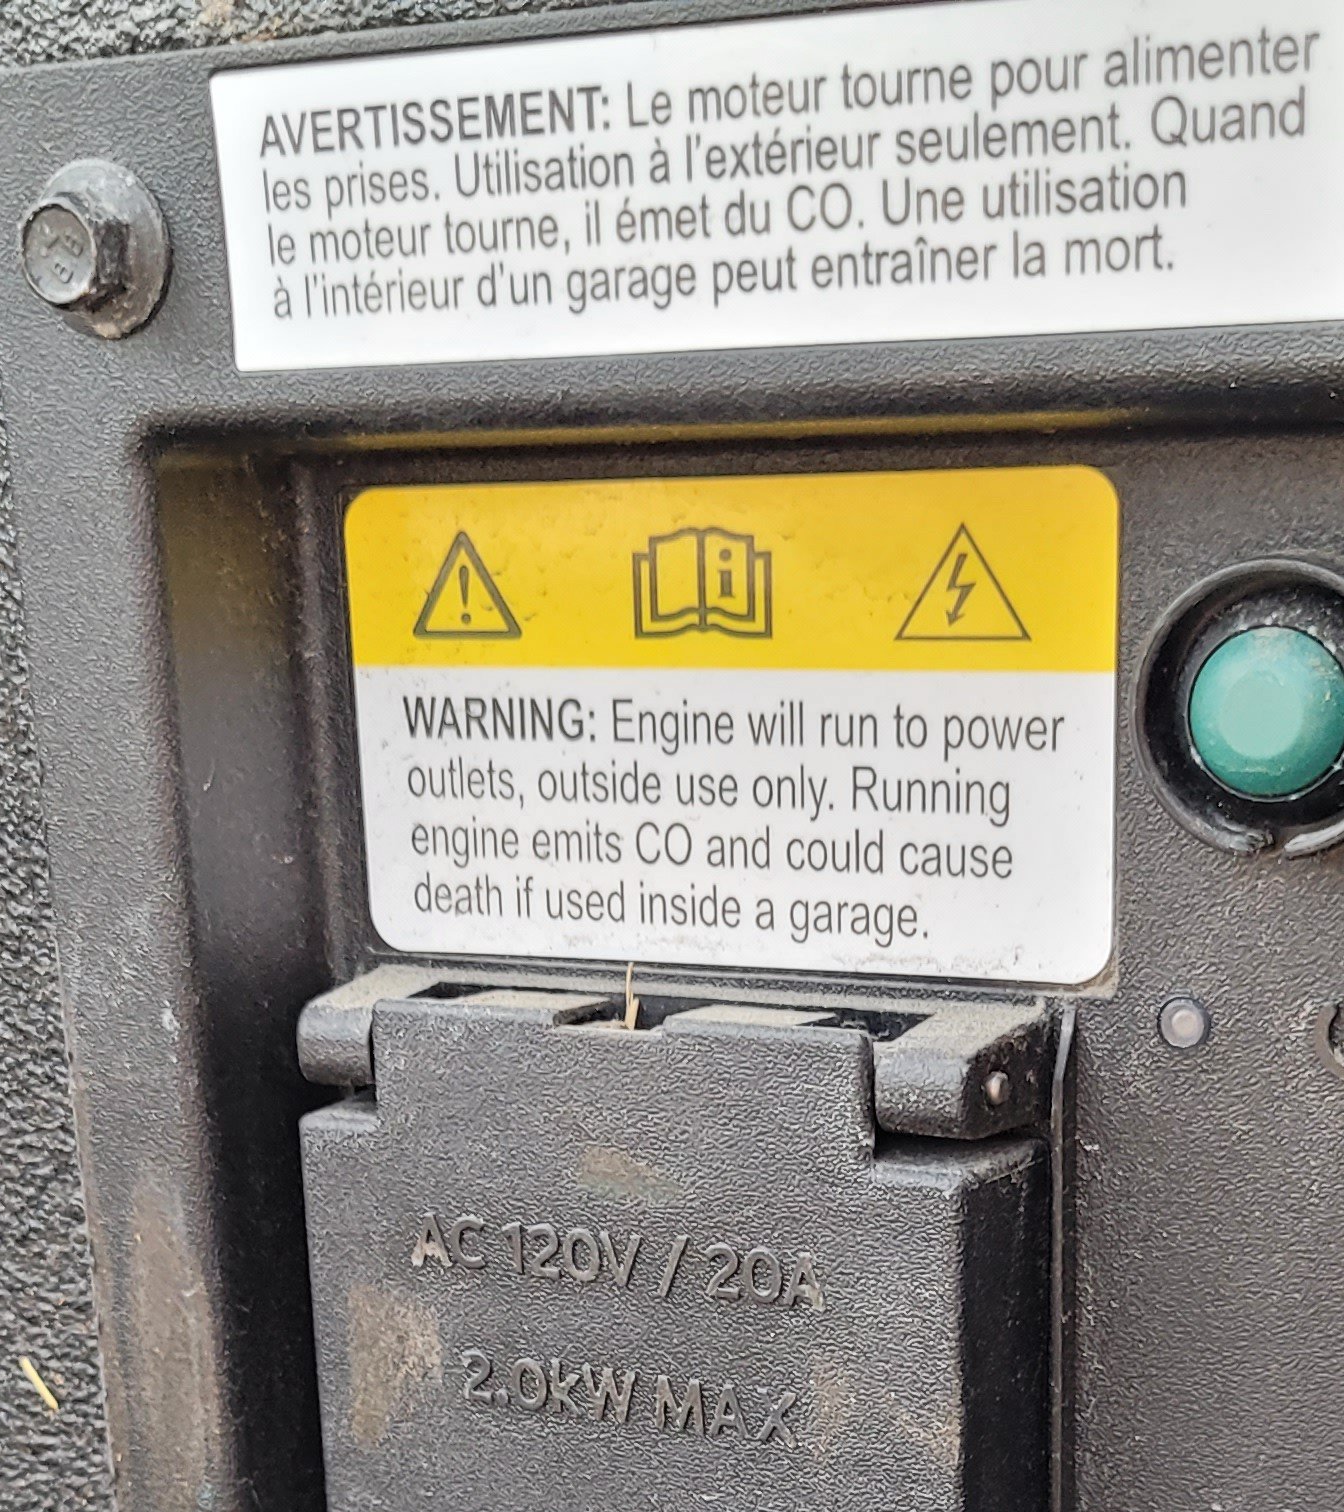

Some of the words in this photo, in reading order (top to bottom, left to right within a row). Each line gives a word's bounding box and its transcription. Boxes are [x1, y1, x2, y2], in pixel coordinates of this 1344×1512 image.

[258, 84, 611, 159] AVERTISSEMENT:
[625, 80, 673, 129] Le
[687, 72, 828, 124] moteur
[840, 62, 974, 111] tourne
[989, 52, 1089, 112] pour
[1103, 26, 1322, 89] alimenter
[261, 168, 313, 214] les
[324, 160, 441, 221] prises.
[453, 142, 636, 199] Utilisation
[648, 136, 672, 185] à
[684, 124, 882, 183] l'extérieur
[894, 102, 1131, 167] seulement.
[1149, 84, 1307, 148] Quand
[266, 222, 297, 267] le
[308, 217, 433, 265] moteur
[443, 211, 571, 256] tourne,
[584, 198, 602, 247] il
[614, 193, 712, 245] émet
[723, 188, 772, 238] du
[786, 180, 865, 234] CO.
[881, 176, 966, 227] Une
[981, 160, 1187, 221] utilisation
[272, 275, 293, 320] à
[303, 267, 466, 319] l'intérieur
[476, 260, 554, 308] d'un
[565, 262, 698, 316] garage
[711, 245, 798, 309] peut
[810, 235, 998, 290] entraîner
[1012, 229, 1047, 279] la
[1064, 223, 1174, 276] mort.
[401, 694, 597, 743] WARNING:
[611, 697, 735, 757] Engine
[746, 698, 805, 748] will
[819, 711, 879, 749] run
[892, 703, 929, 750] to
[942, 713, 1066, 764] power
[406, 754, 525, 810] outlets,
[536, 758, 663, 806] outside
[675, 772, 740, 809] use
[751, 762, 835, 823] only.
[851, 764, 1011, 829] Running
[410, 814, 520, 870] engine
[530, 818, 623, 865] emits
[634, 820, 694, 867] CO
[705, 823, 772, 871] and
[785, 827, 885, 876] could
[898, 840, 1014, 881] cause
[413, 870, 504, 918] death
[514, 874, 535, 920] if
[544, 879, 627, 924] used
[638, 879, 742, 930] inside
[754, 896, 776, 932] a
[788, 898, 929, 949] garage.
[411, 1212, 486, 1269] AC
[502, 1221, 641, 1287] 120V
[704, 1242, 826, 1312] 20A
[656, 1374, 798, 1448] MAX
